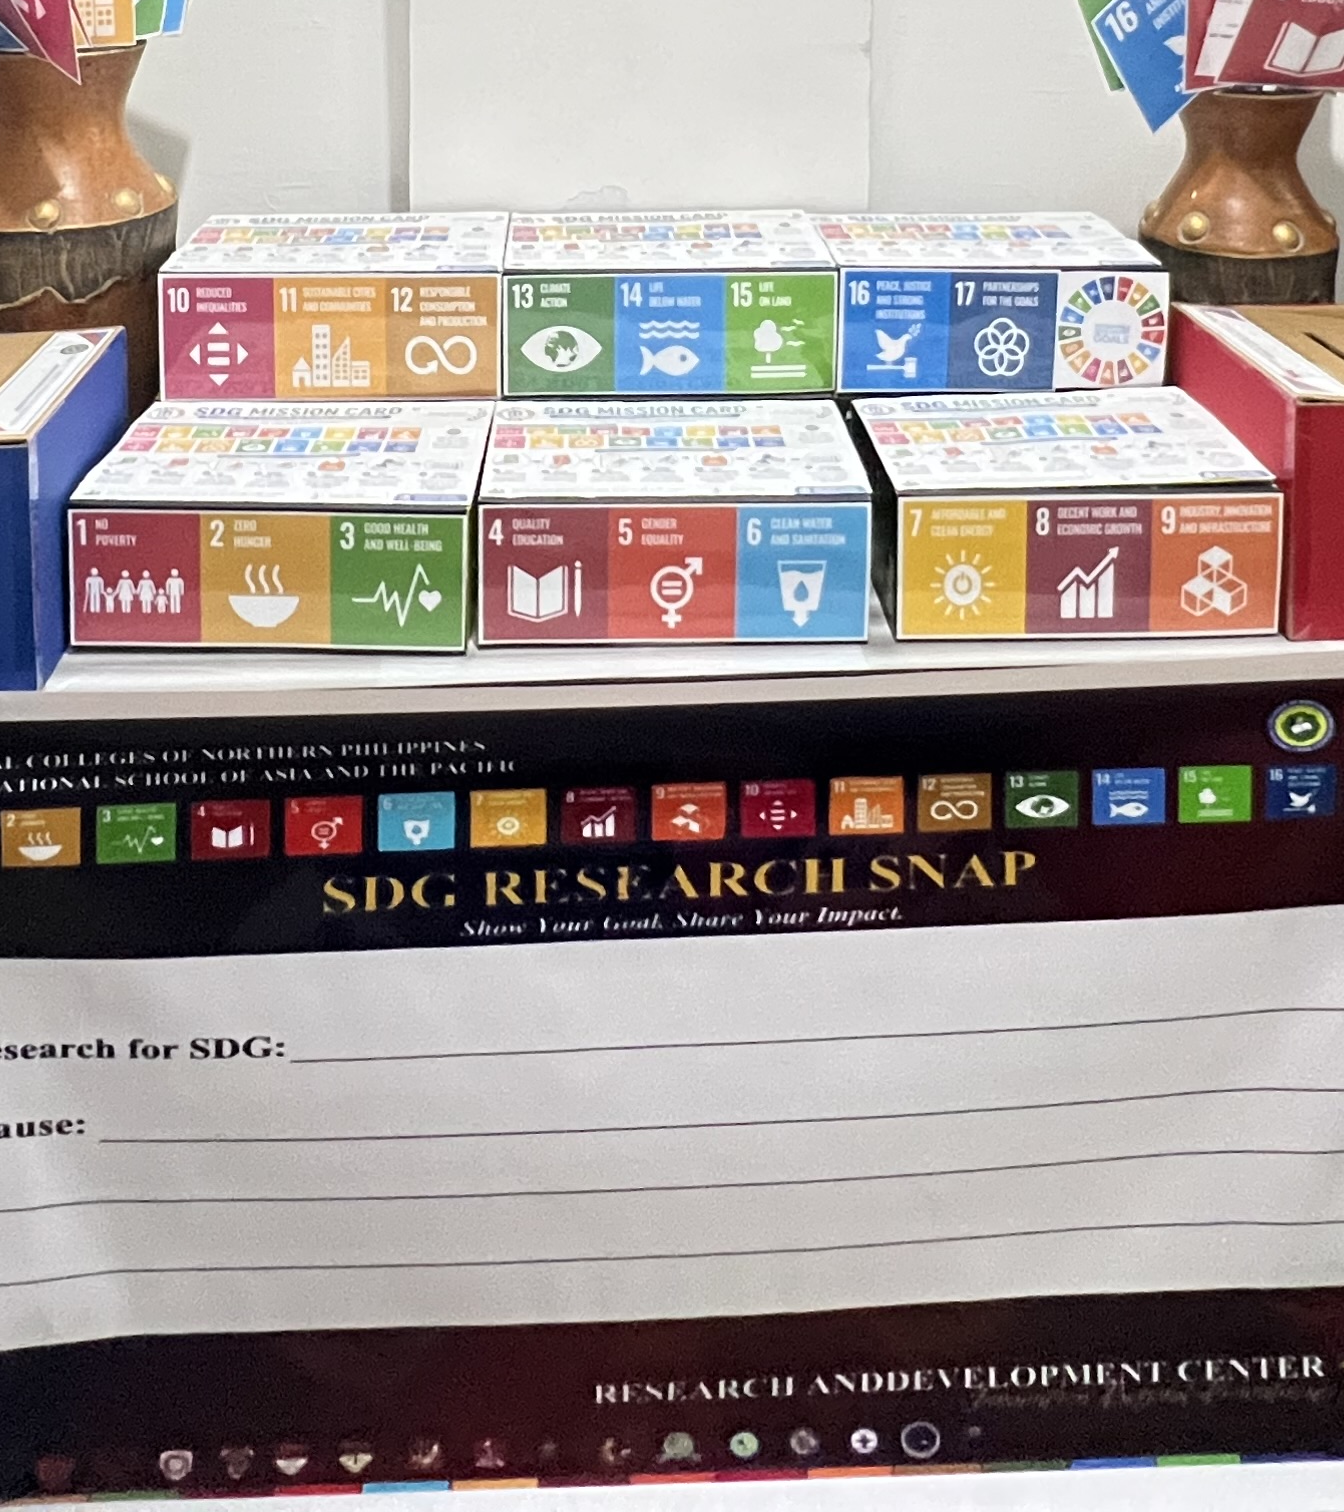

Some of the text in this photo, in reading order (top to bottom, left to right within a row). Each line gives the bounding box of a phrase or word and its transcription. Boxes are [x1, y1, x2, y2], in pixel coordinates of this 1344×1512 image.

[1105, 1, 1138, 42] 16
[167, 288, 190, 313] 10
[279, 288, 297, 312] 11
[391, 288, 413, 312] 12
[512, 283, 533, 308] 13
[620, 282, 642, 307] 14
[731, 282, 752, 307] 15
[849, 280, 870, 305] 16
[955, 281, 975, 306] 17
[196, 302, 247, 312] INEQUALITIES
[194, 406, 403, 418] SDG MISSION CARD
[598, 405, 685, 416] MISSION
[691, 404, 747, 415] CARD
[95, 519, 108, 530] NO
[512, 519, 550, 531] QUALITY
[910, 509, 922, 536] 7
[1035, 507, 1050, 535] 8
[1058, 506, 1137, 519] DECENT WORK AND
[1161, 506, 1176, 534] 9
[76, 519, 88, 545] 1
[210, 520, 224, 547] 2
[234, 520, 257, 532] ZERO
[340, 521, 355, 550] 3
[364, 522, 429, 536] GOOD HEALTH
[488, 518, 504, 546] 4
[618, 518, 633, 546] 5
[746, 517, 762, 546] 6
[95, 534, 137, 547] POVERTY
[364, 538, 384, 551] AND
[512, 534, 564, 546] EDUCATION
[642, 533, 684, 546] EQUALITY
[26, 751, 158, 769] COLLEGES
[163, 748, 193, 764] OF
[201, 743, 333, 763] NORTHERN
[341, 740, 486, 759] PHILIPPINES
[114, 769, 214, 788] SCHOOL
[220, 768, 247, 785] OF
[258, 763, 319, 782] ASIA
[325, 761, 370, 780] AND
[377, 760, 422, 778] THE
[102, 809, 111, 823] 3
[322, 851, 1037, 915] SDG RESEARCH SNAP
[460, 920, 526, 937] Show
[539, 918, 594, 934] Your
[673, 911, 744, 929] Share
[755, 909, 810, 926] Your
[128, 1037, 179, 1061] for
[190, 1035, 287, 1061] SDG:
[594, 1374, 796, 1405] RESEARCH
[1177, 1354, 1326, 1384] CENTER
